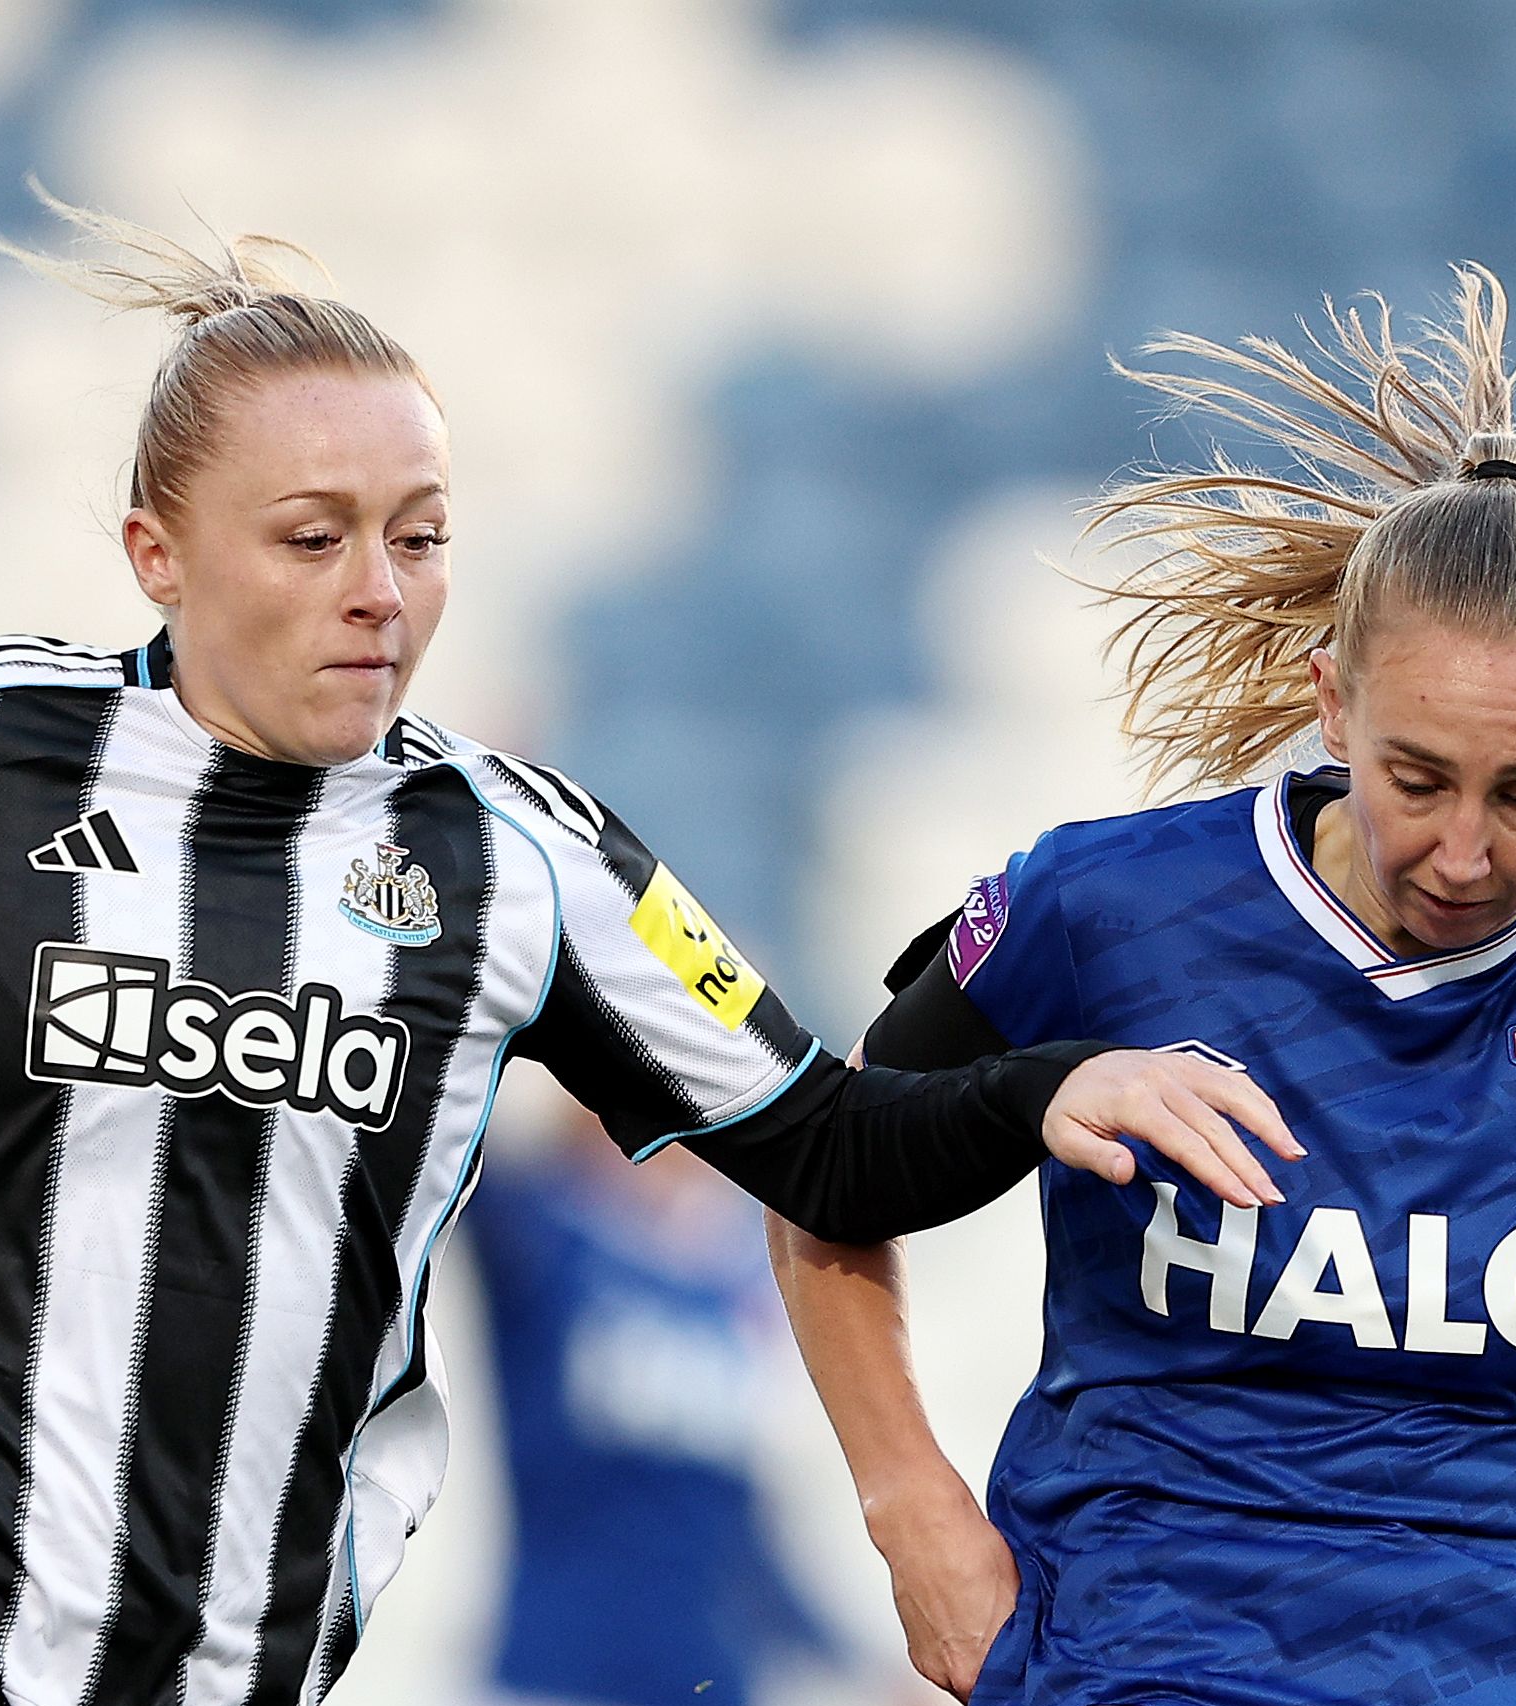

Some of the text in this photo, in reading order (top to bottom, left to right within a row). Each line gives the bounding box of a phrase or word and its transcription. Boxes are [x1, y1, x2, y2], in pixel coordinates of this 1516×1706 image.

[352, 915, 425, 941] NEWCASTLE UNITED
[157, 998, 398, 1116] sela
